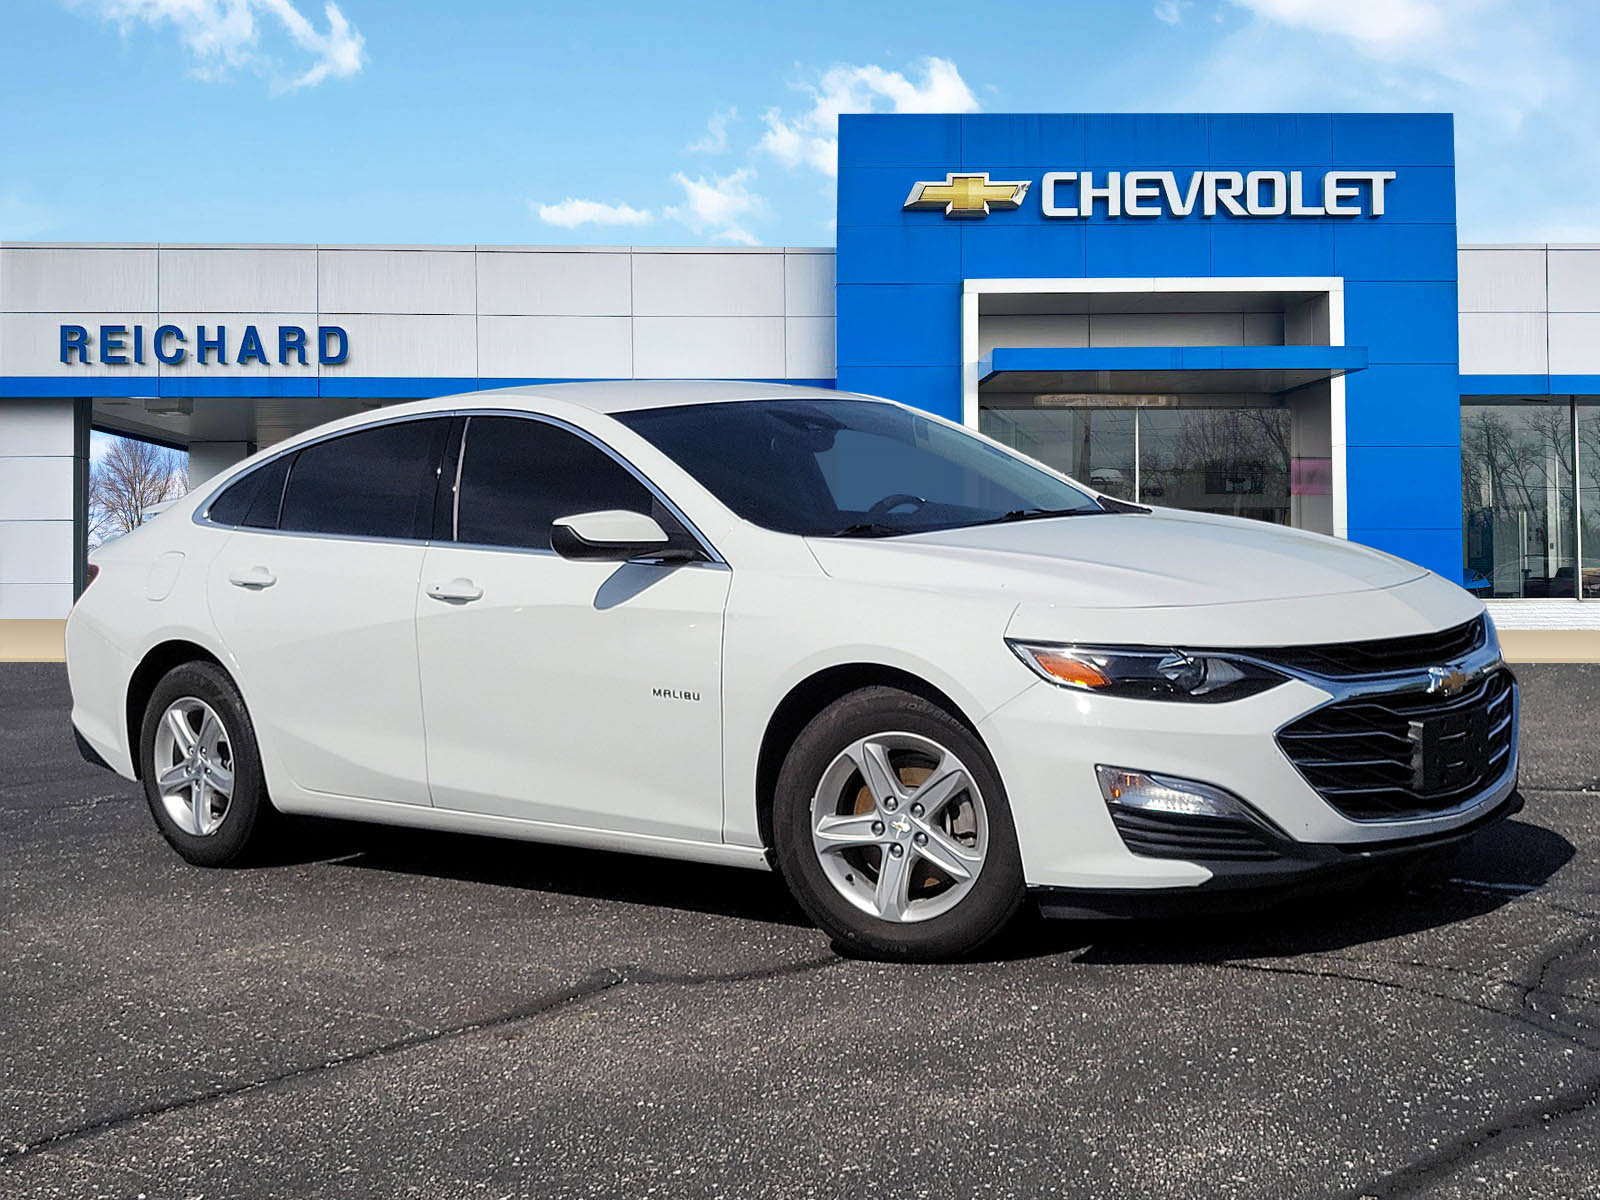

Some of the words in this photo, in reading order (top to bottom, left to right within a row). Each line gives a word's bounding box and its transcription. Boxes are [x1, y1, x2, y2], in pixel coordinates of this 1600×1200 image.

[1041, 171, 1396, 217] CHEVROLET
[59, 324, 351, 365] REICHARD
[652, 687, 701, 701] MALIBU
